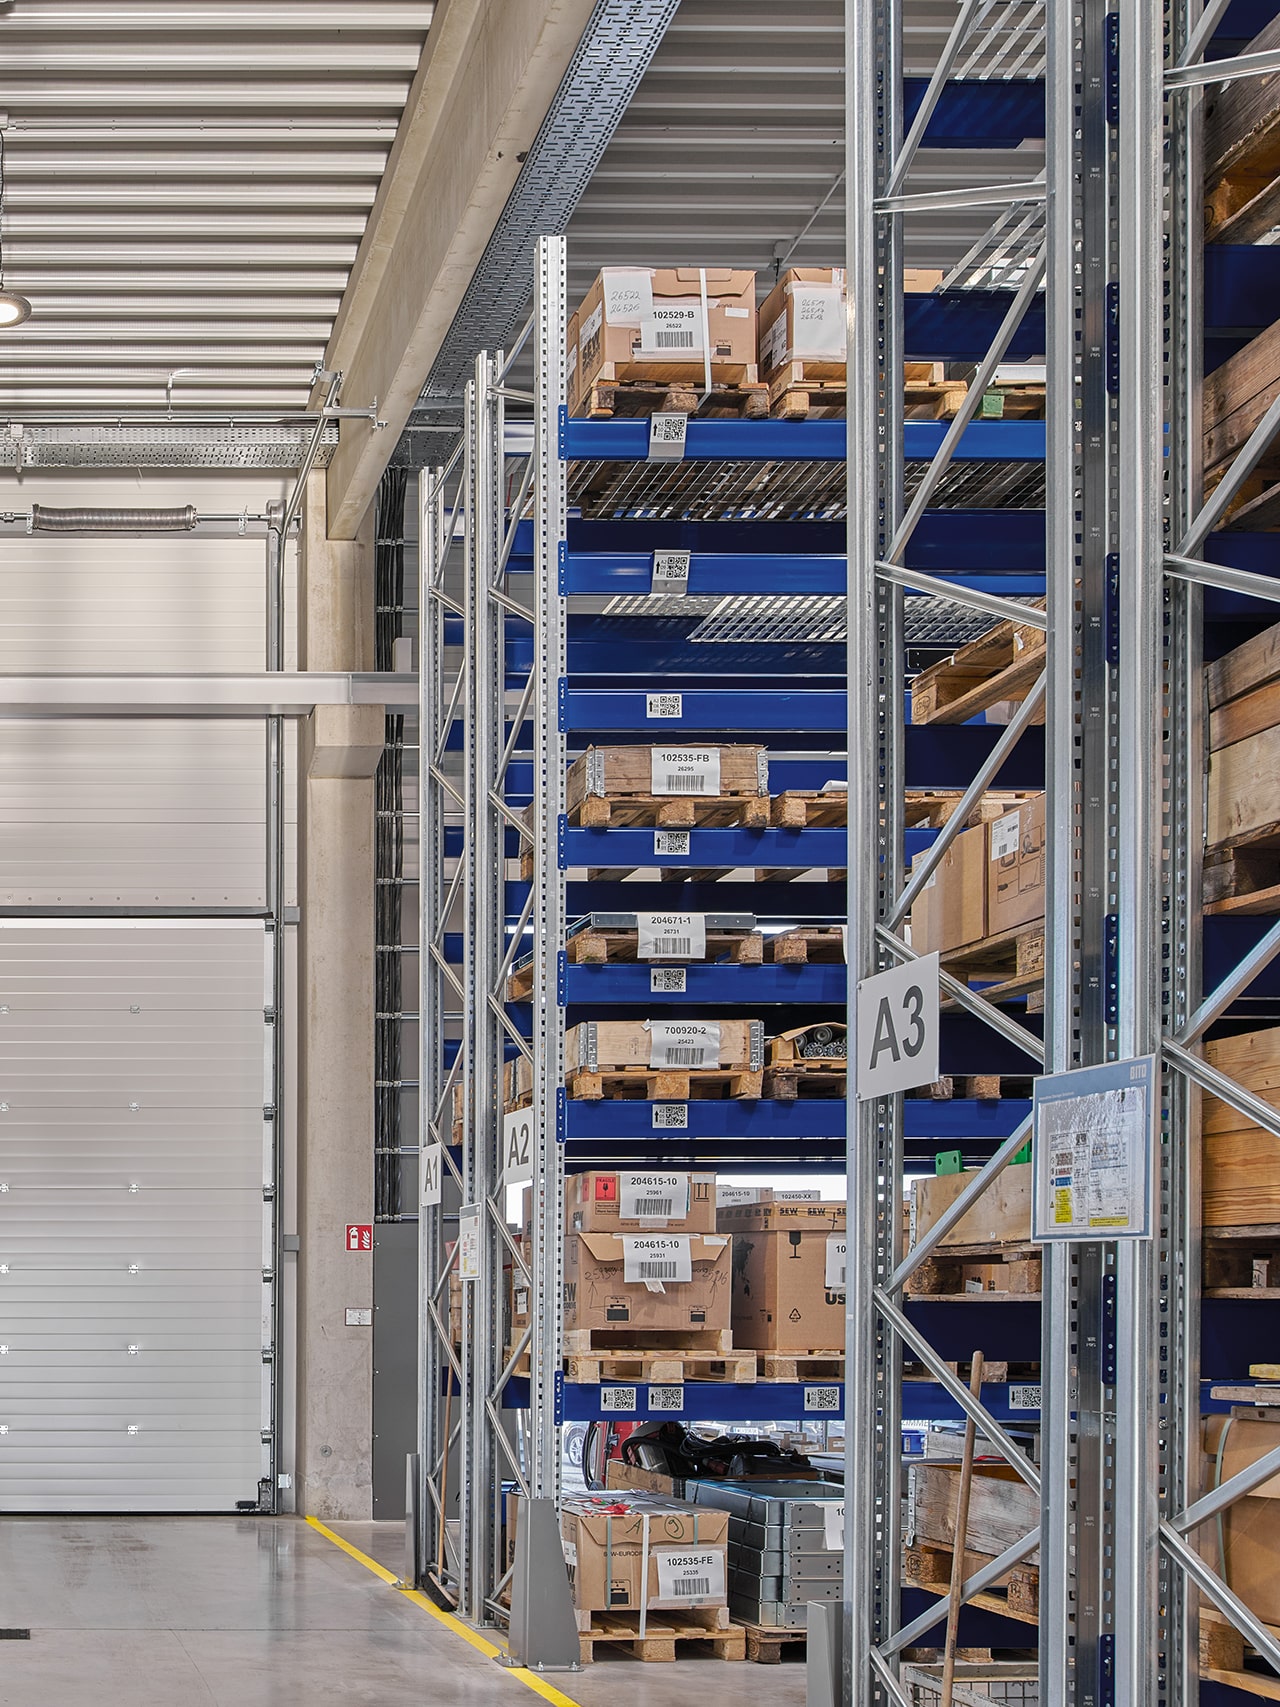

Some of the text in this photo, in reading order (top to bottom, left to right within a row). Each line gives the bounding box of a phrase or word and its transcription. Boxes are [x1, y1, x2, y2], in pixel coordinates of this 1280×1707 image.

[652, 310, 695, 319] 102529-B
[661, 753, 710, 762] 102535-FB
[651, 916, 691, 924] 204671-1
[665, 1026, 707, 1034] 700920-2
[869, 985, 926, 1070] A3
[1129, 1063, 1147, 1080] BITO
[508, 1123, 530, 1169] A2
[424, 1155, 439, 1193] A1
[631, 1177, 678, 1186] 204615-10
[633, 1240, 680, 1249] 204615-10
[667, 1555, 713, 1566] 102535-FE
